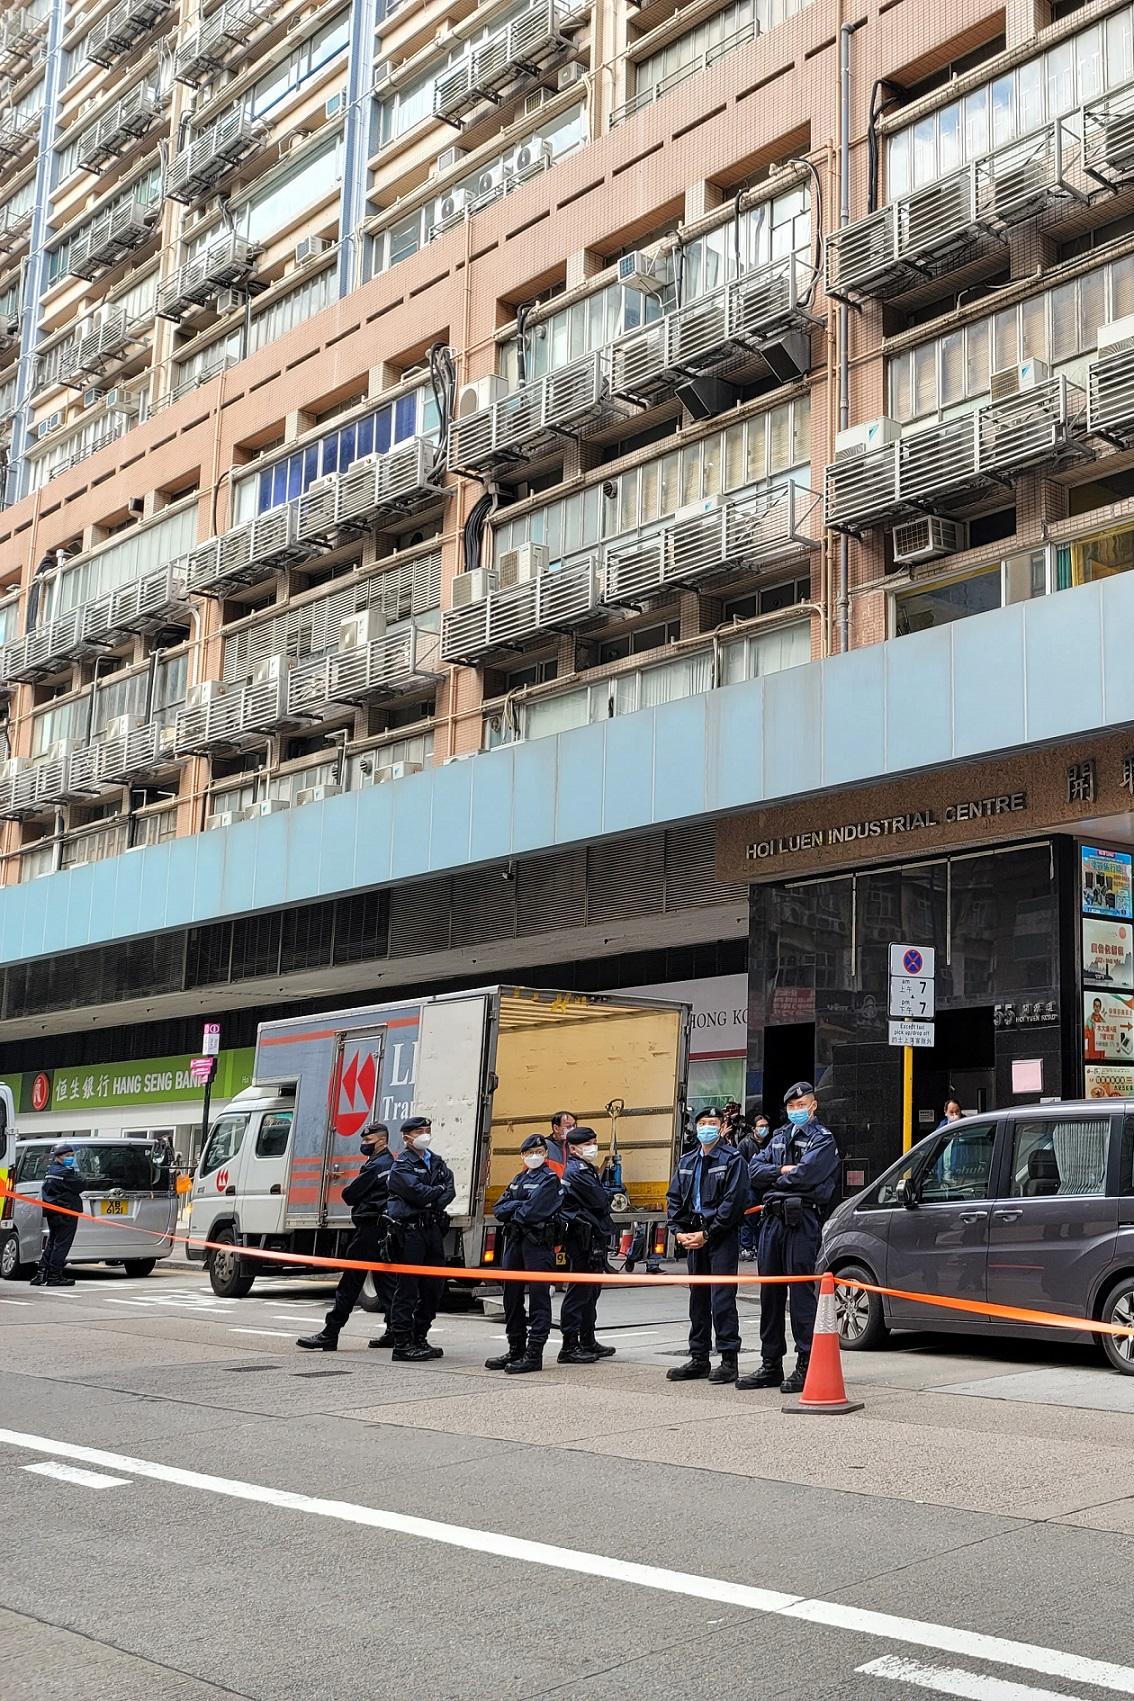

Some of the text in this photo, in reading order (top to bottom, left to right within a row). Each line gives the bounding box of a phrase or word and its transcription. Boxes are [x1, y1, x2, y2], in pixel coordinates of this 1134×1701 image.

[745, 792, 1027, 860] HOI LUEN INDUSTRIAL CENTRE
[899, 985, 912, 993] 上午
[919, 981, 927, 994] 7
[900, 1006, 912, 1015] 下午
[919, 1002, 927, 1015] 7
[993, 1004, 1016, 1026] 55
[56, 1074, 110, 1102] 恒生銀行
[112, 1070, 206, 1095] HANG SENG BAN
[106, 1206, 123, 1215] 6121
[109, 1200, 121, 1208] XB
